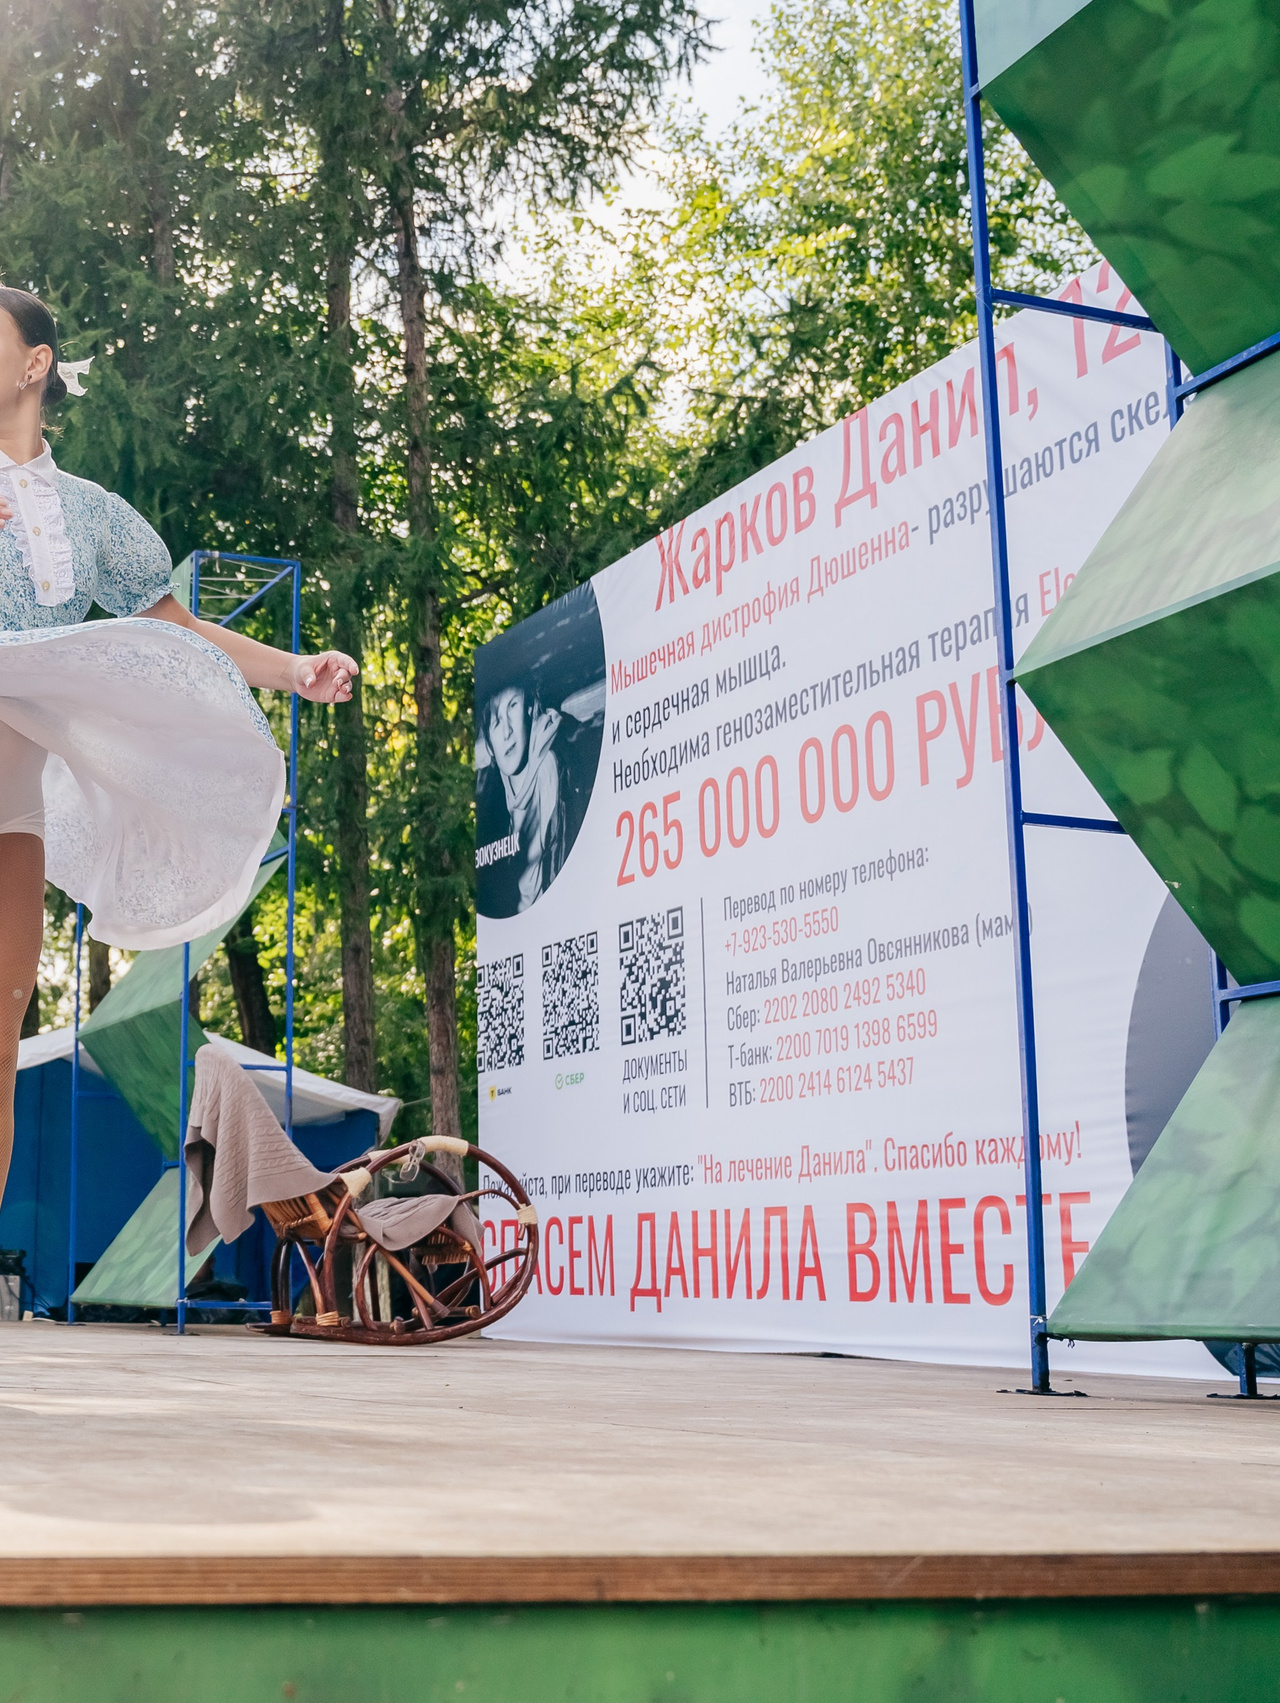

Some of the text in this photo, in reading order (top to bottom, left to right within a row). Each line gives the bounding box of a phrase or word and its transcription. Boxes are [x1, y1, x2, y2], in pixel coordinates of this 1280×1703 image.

[655, 466, 816, 612] Жарков
[611, 631, 695, 695] Мышечная
[701, 576, 800, 656] дистрофия
[612, 644, 786, 745] и сердечная мышца.
[613, 731, 710, 793] Необходима
[716, 640, 920, 752] генозаместительная
[928, 593, 1029, 662] терапя
[616, 665, 1045, 887] 265 000 000 РУБ
[724, 847, 929, 922] Перевод по номеру телефона:
[724, 906, 839, 957] +7-923-530-5550
[726, 902, 1033, 996] Наталья Валерьевна Овсянникова (мам)
[727, 968, 926, 1032] Сбер: 2202 2080 2492 5340
[623, 1049, 687, 1084] ДОКУМЕНТЫ
[728, 1009, 937, 1069] Т-банк: 2200 7019 1398 6599
[497, 1087, 512, 1096] БАНК
[565, 1072, 584, 1086] СБЕР
[623, 1085, 686, 1114] И СОЦ. СЕТИ
[729, 1057, 914, 1107] ВТБ: 2200 2414 6124 5437
[483, 1172, 548, 1200] Пожайста,
[551, 1174, 571, 1198] при
[575, 1169, 631, 1198] переводе
[636, 1164, 694, 1194] укажите:
[697, 1154, 722, 1184] "На
[728, 1156, 792, 1183] лечение
[884, 1131, 967, 1172] Спасибо
[630, 1204, 827, 1313] ДАНИЛА
